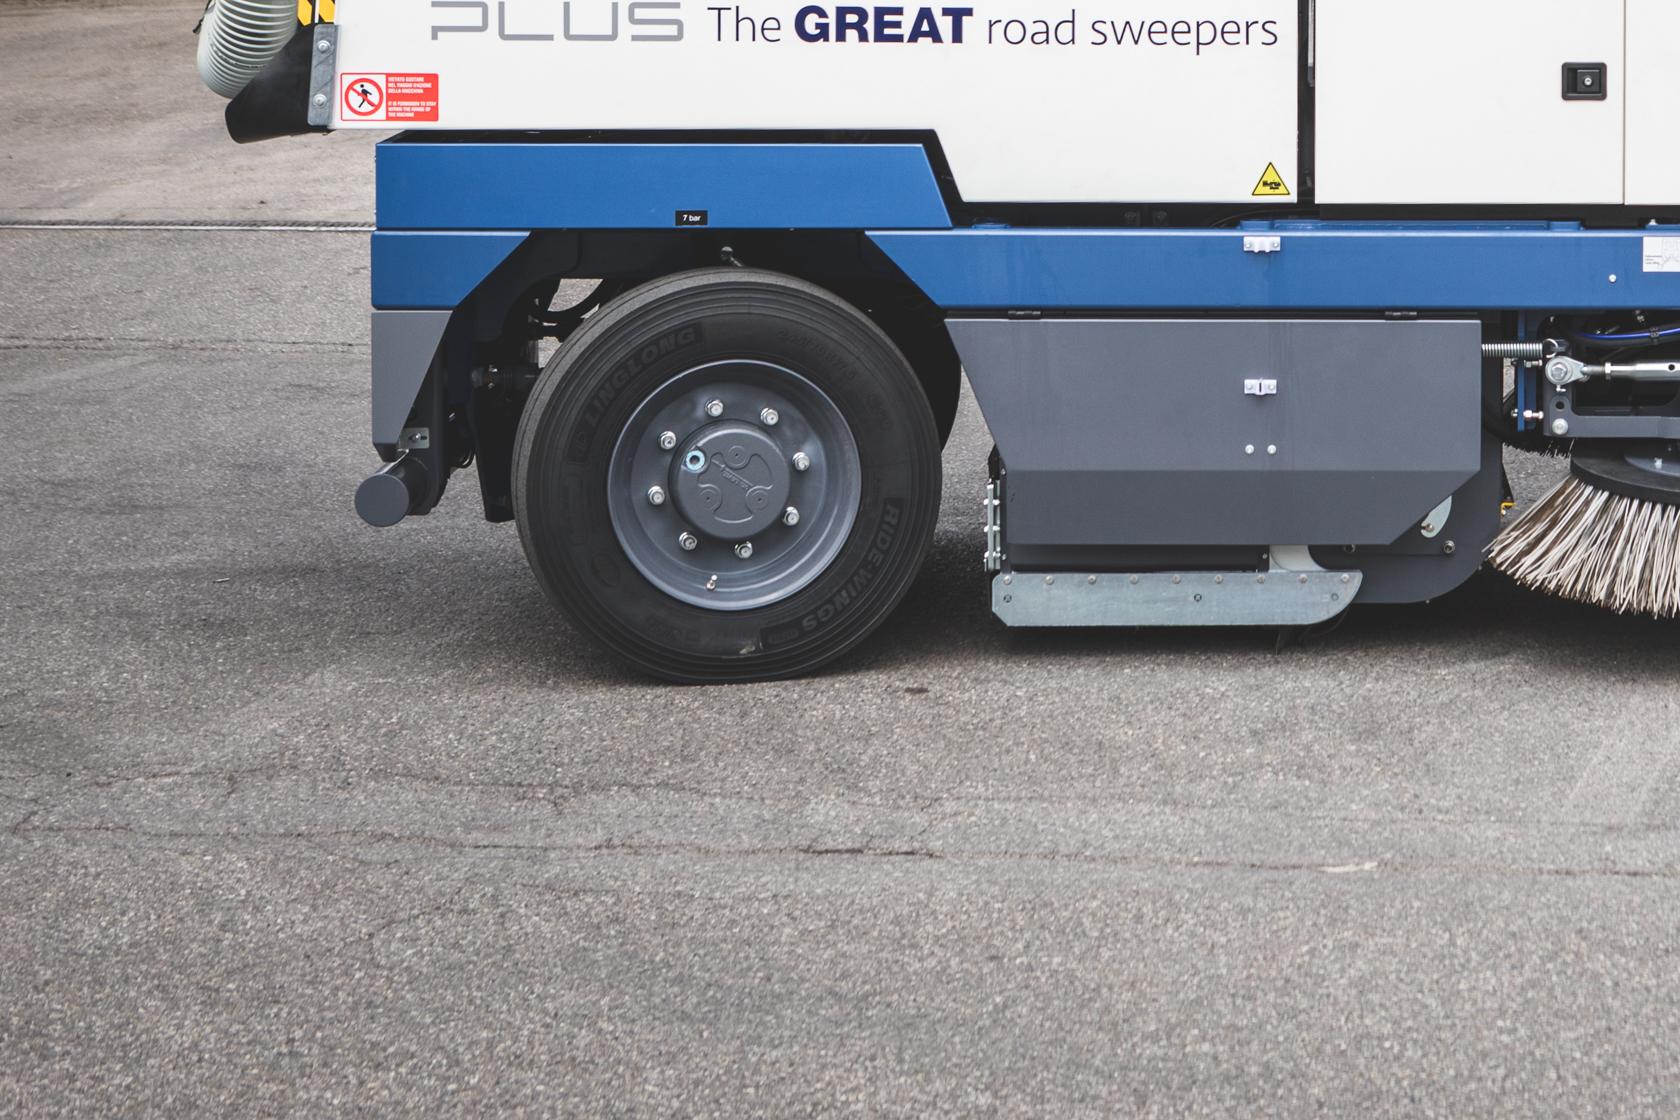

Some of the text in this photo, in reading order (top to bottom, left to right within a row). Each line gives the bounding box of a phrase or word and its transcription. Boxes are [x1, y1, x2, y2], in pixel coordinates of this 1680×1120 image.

[430, 0, 684, 42] PLUS
[706, 5, 1278, 56] The GREAT road sweepers
[585, 326, 696, 428] LINGLONG
